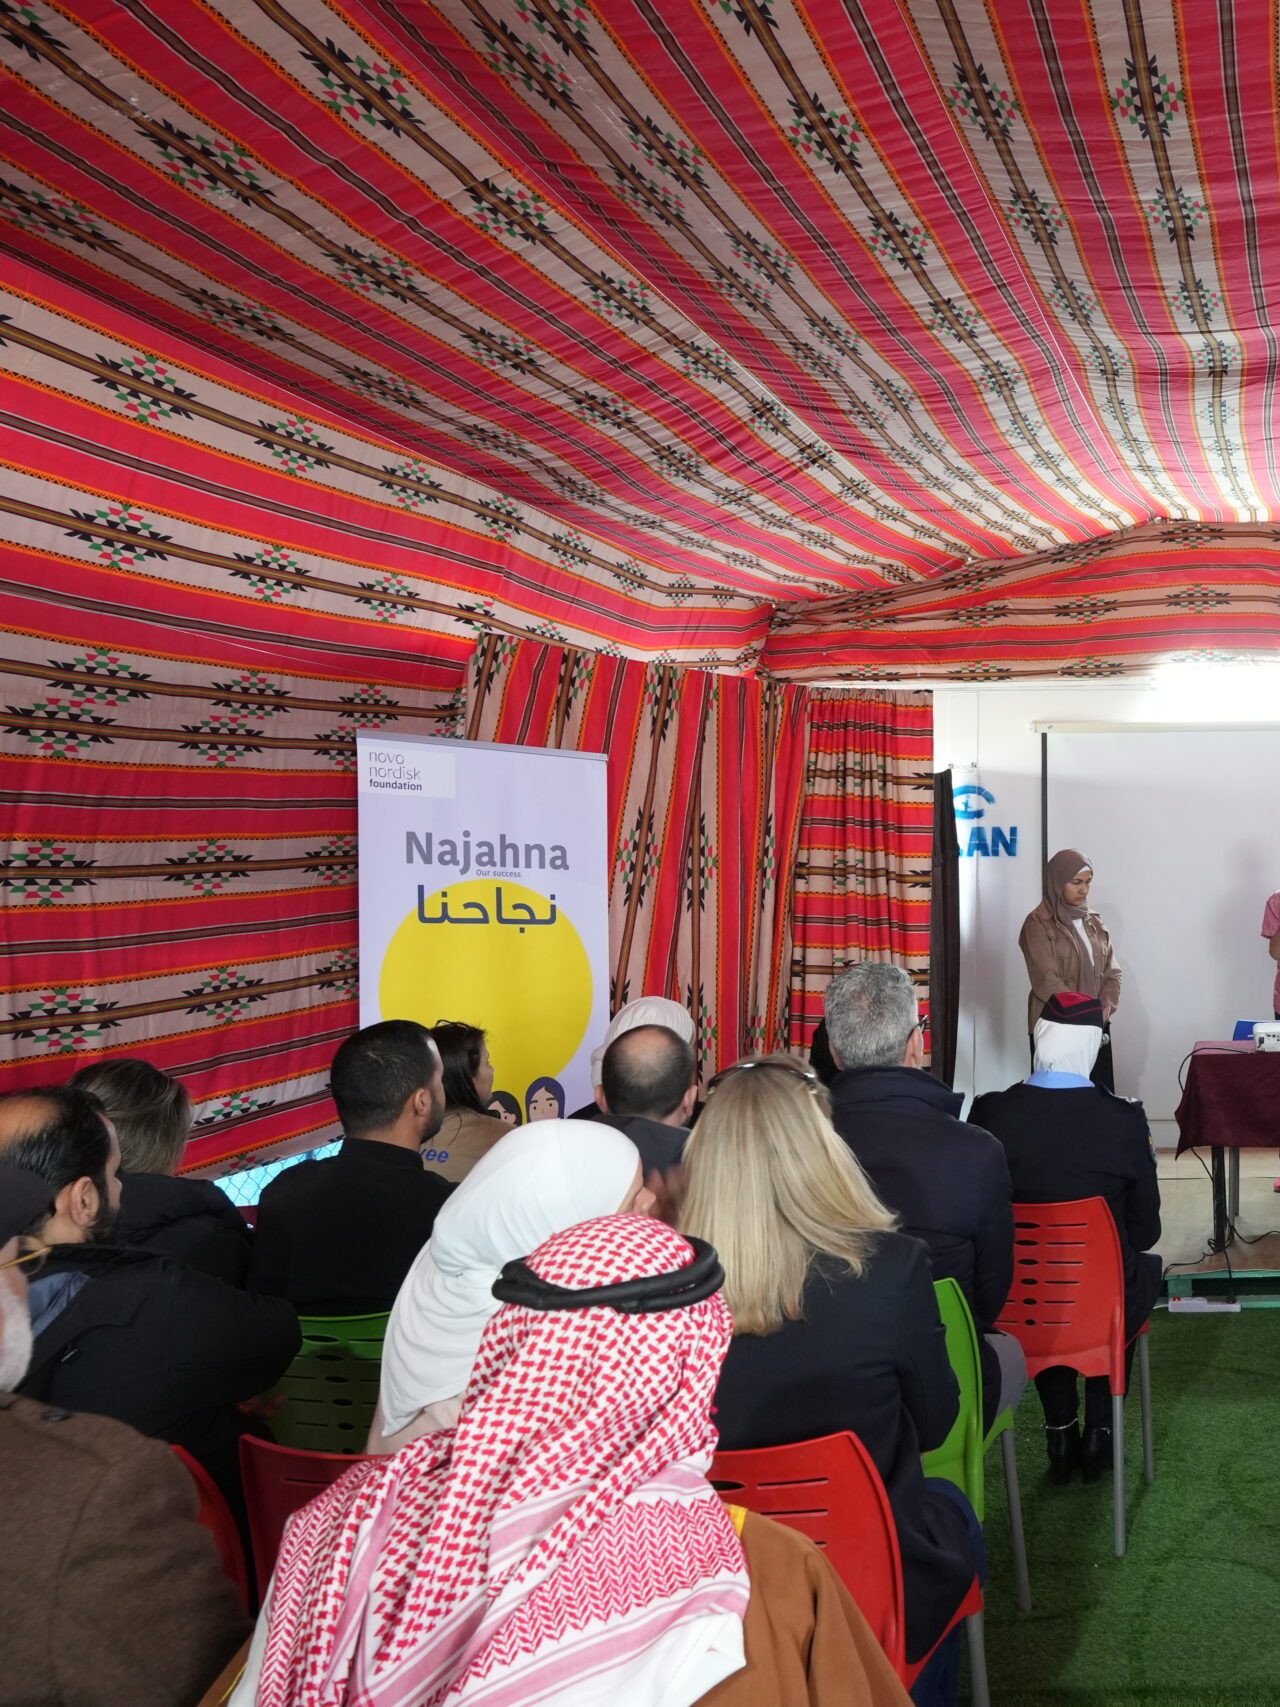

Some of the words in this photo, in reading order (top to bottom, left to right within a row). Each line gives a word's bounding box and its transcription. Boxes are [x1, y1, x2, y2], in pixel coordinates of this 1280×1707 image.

[369, 751, 405, 765] novo
[369, 766, 421, 780] nordisk
[369, 778, 422, 791] foundation
[960, 826, 1018, 857] AN
[405, 830, 569, 875] Najahna
[476, 869, 491, 877] Our
[493, 870, 521, 878] success
[417, 884, 557, 934] نجاحنا
